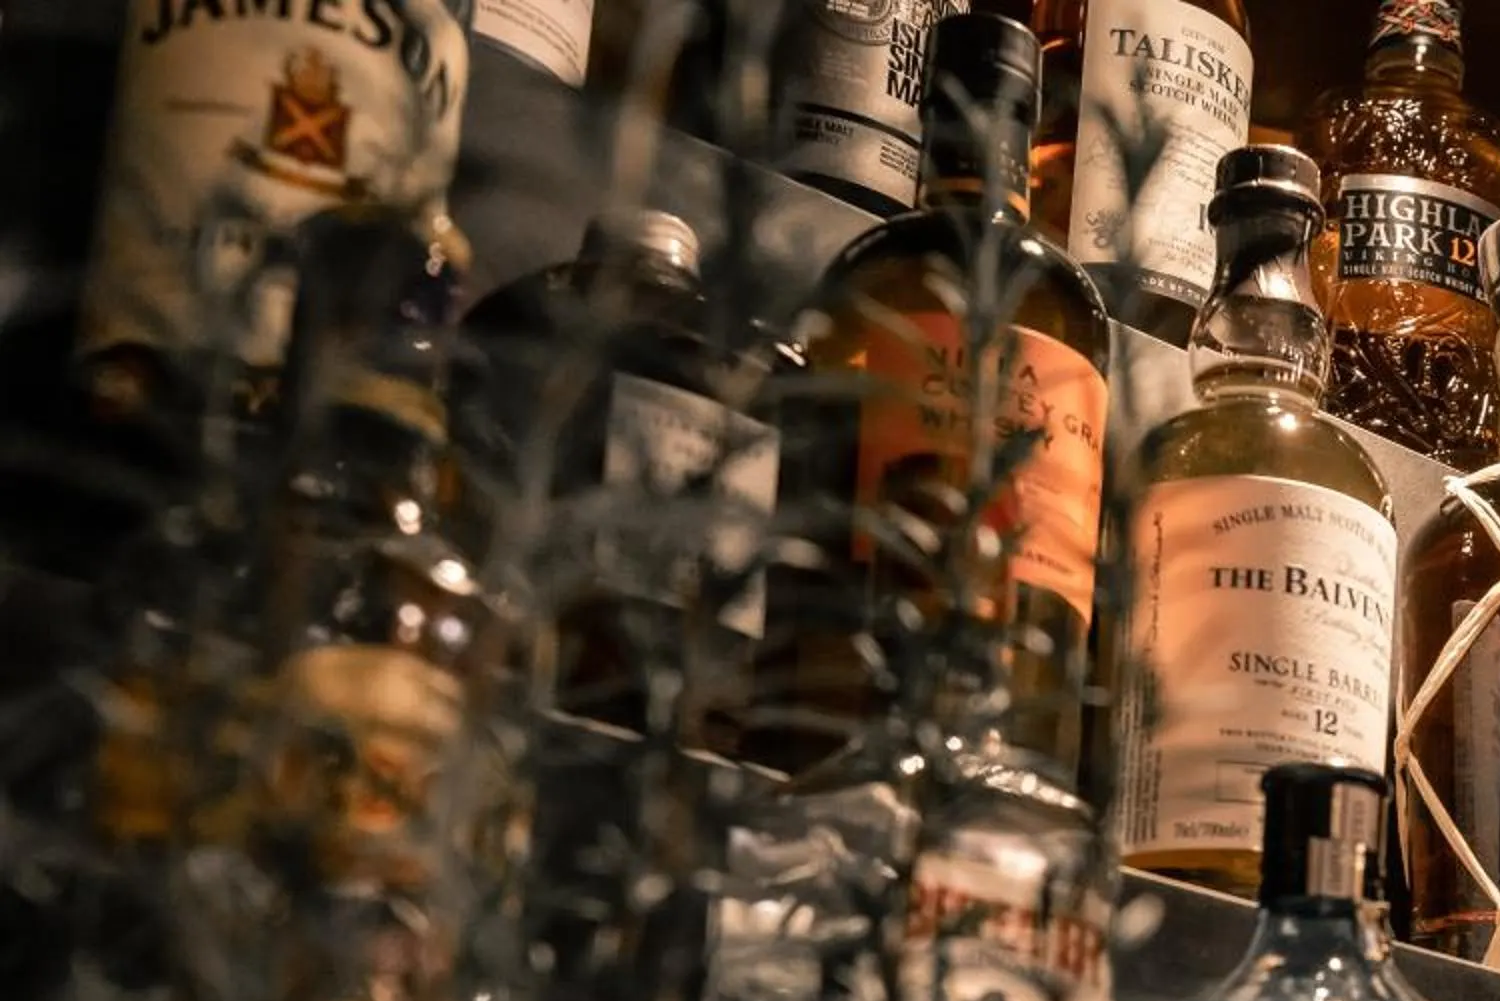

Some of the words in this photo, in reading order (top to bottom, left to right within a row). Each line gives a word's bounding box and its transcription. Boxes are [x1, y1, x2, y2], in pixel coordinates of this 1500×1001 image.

[1345, 193, 1482, 239] HIGHLA
[1344, 223, 1444, 257] PARK
[1451, 237, 1475, 267] 12
[1344, 251, 1434, 268] VIKING
[1213, 505, 1277, 536] SINGLE
[1281, 503, 1325, 523] MALT
[1209, 565, 1274, 592] THE
[1228, 651, 1320, 685] SINGLE
[1313, 708, 1340, 737] 12
